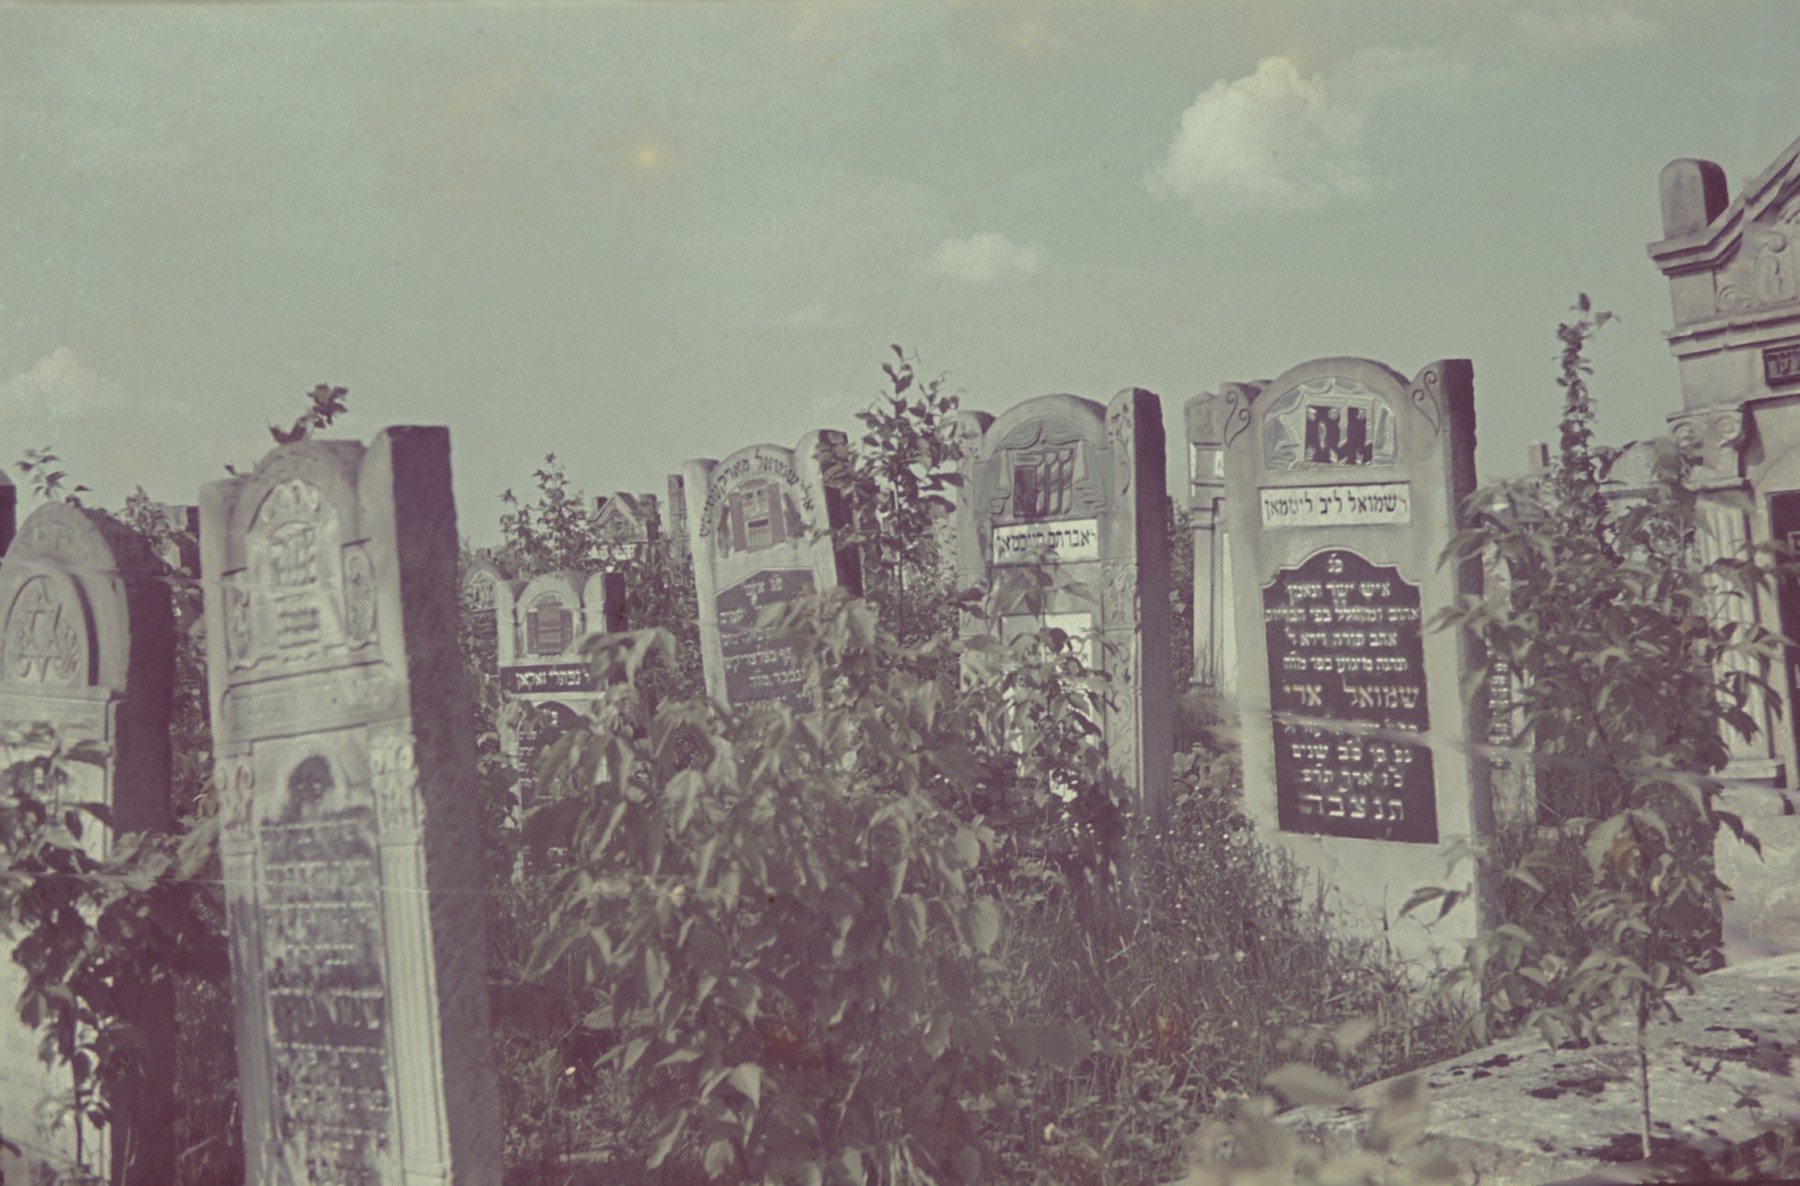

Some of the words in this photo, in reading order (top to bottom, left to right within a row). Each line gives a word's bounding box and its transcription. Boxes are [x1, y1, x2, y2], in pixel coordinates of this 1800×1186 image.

[755, 447, 799, 485] שמואל
[1349, 490, 1398, 513] שמואל
[1360, 581, 1391, 598] איש
[1333, 632, 1365, 647] תורה
[1342, 674, 1420, 709] שמואל
[1341, 771, 1374, 786] אדר
